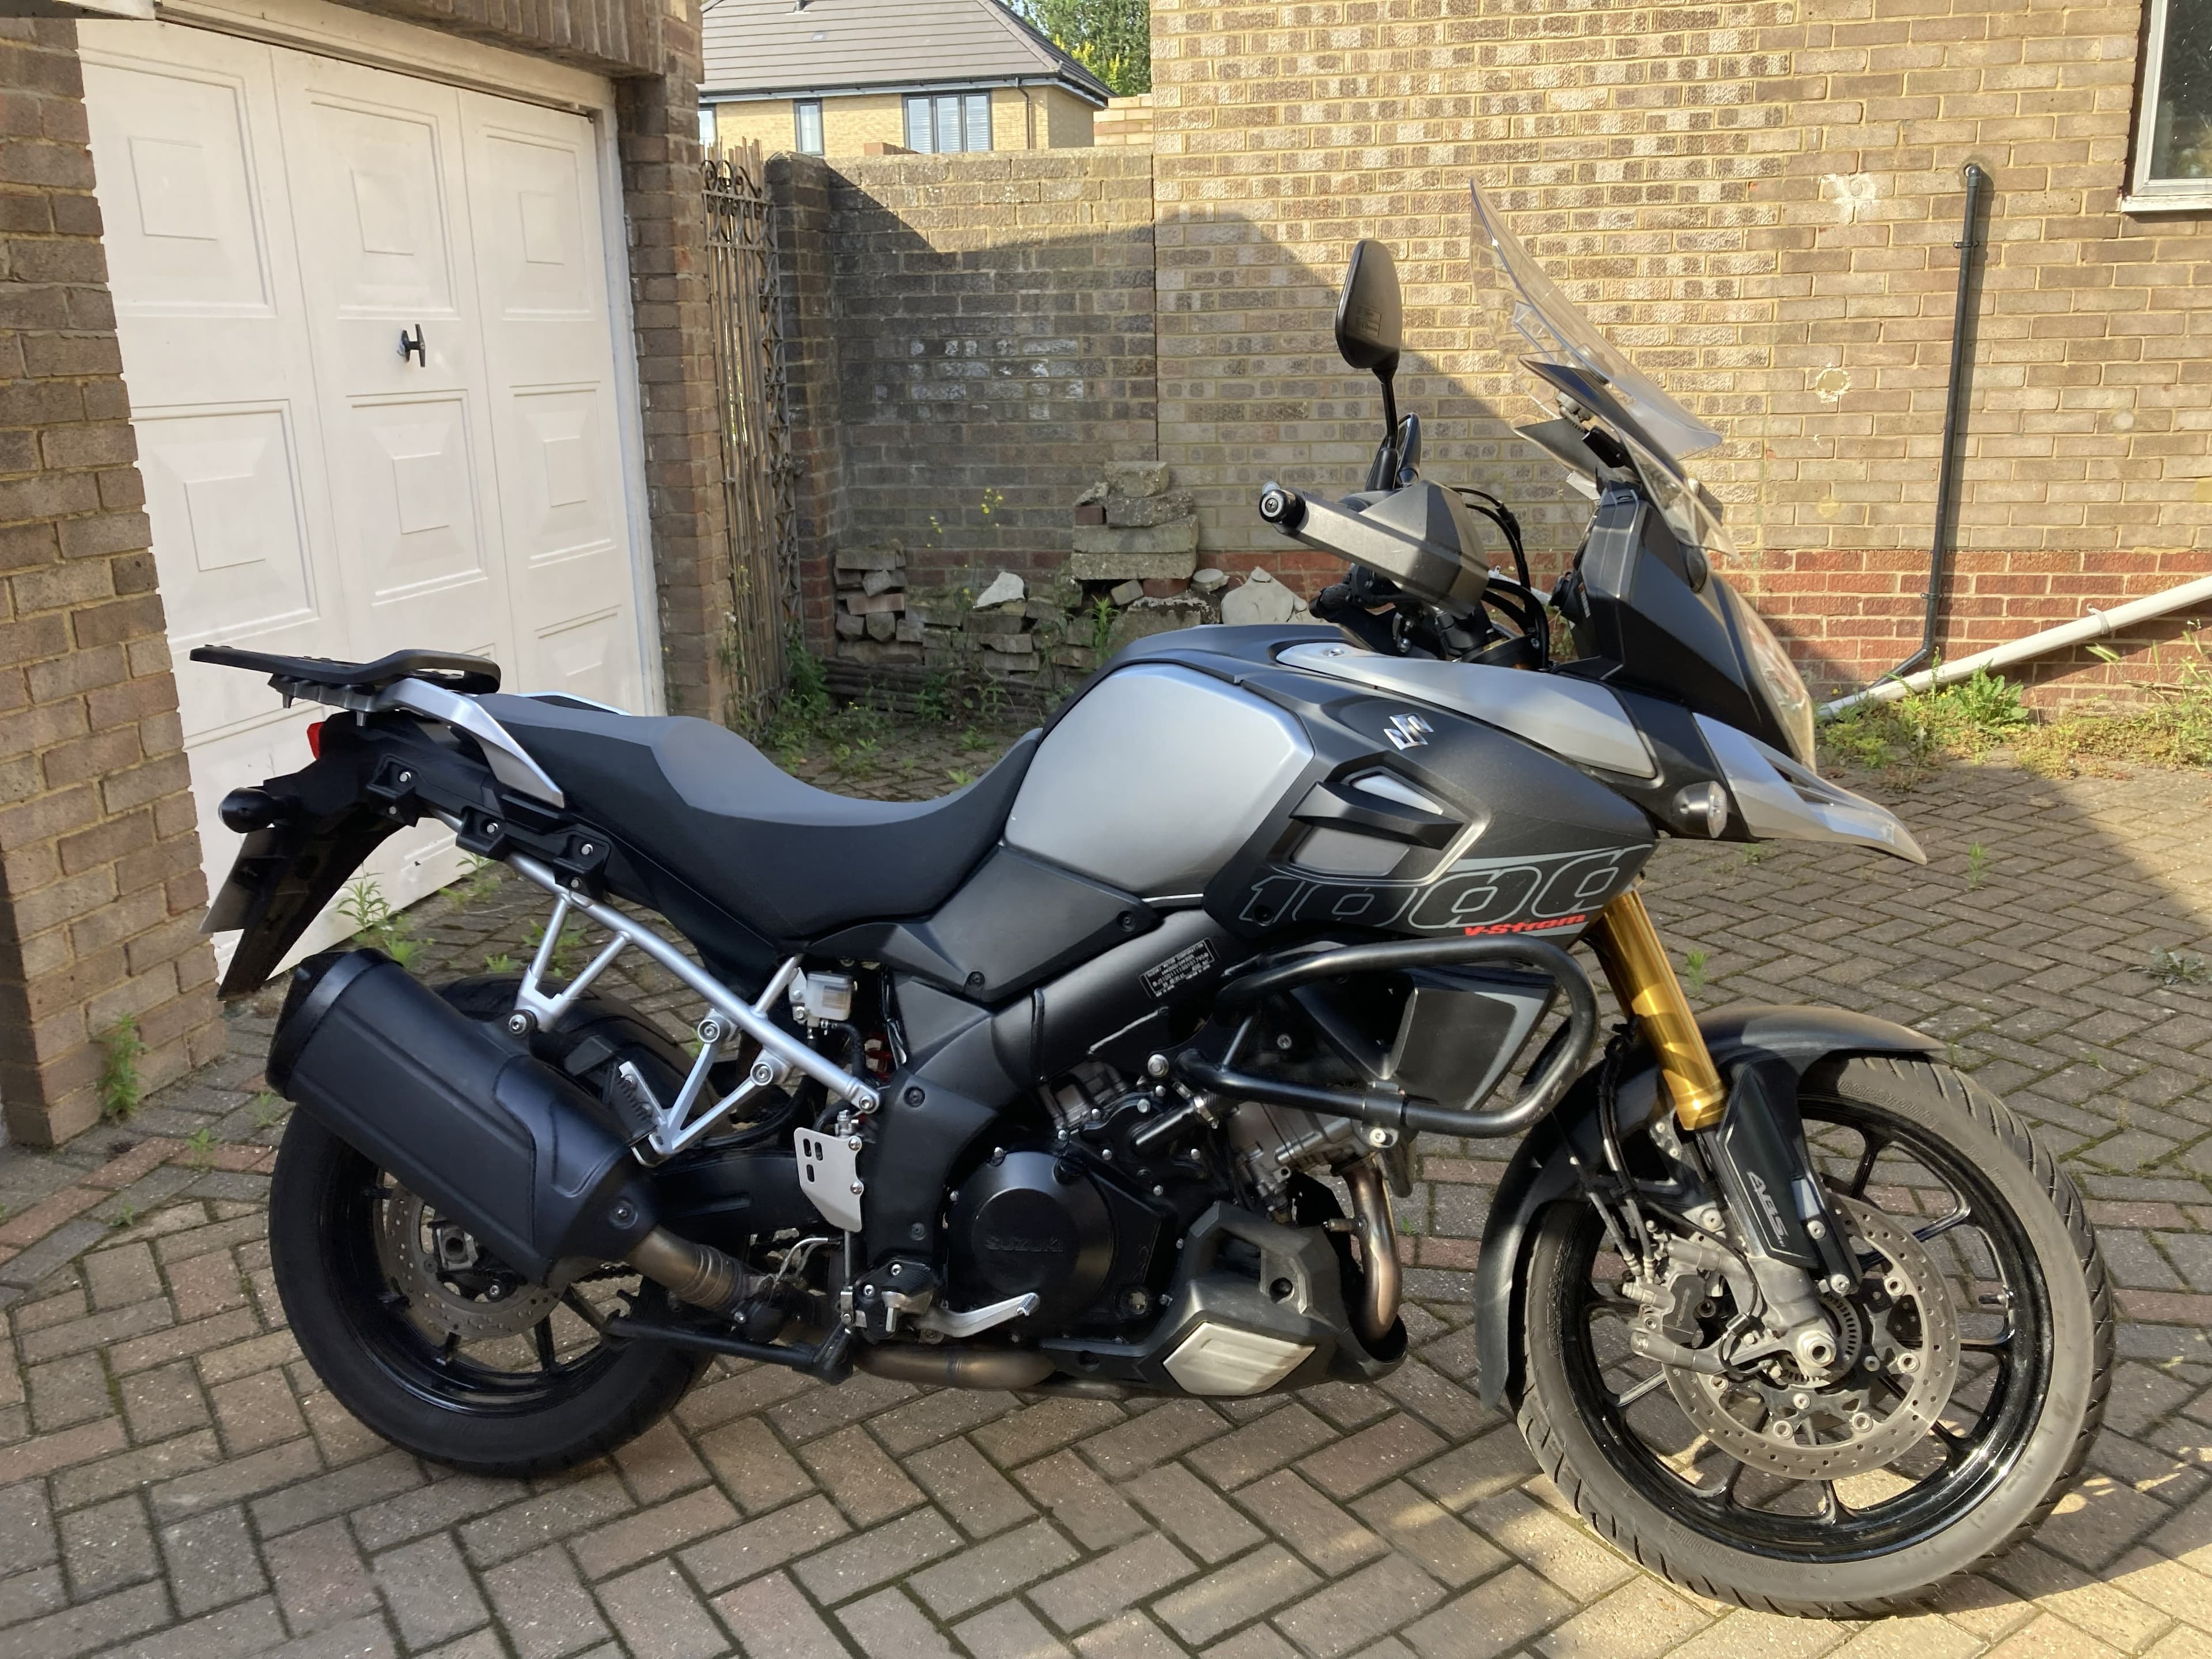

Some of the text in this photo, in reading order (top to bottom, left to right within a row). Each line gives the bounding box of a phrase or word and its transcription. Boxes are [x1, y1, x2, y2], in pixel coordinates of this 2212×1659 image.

[1239, 843, 1653, 929] 1000
[1465, 914, 1586, 935] V-Strom
[1747, 1172, 1789, 1248] ABS
[984, 1236, 1064, 1252] SUZUKI
